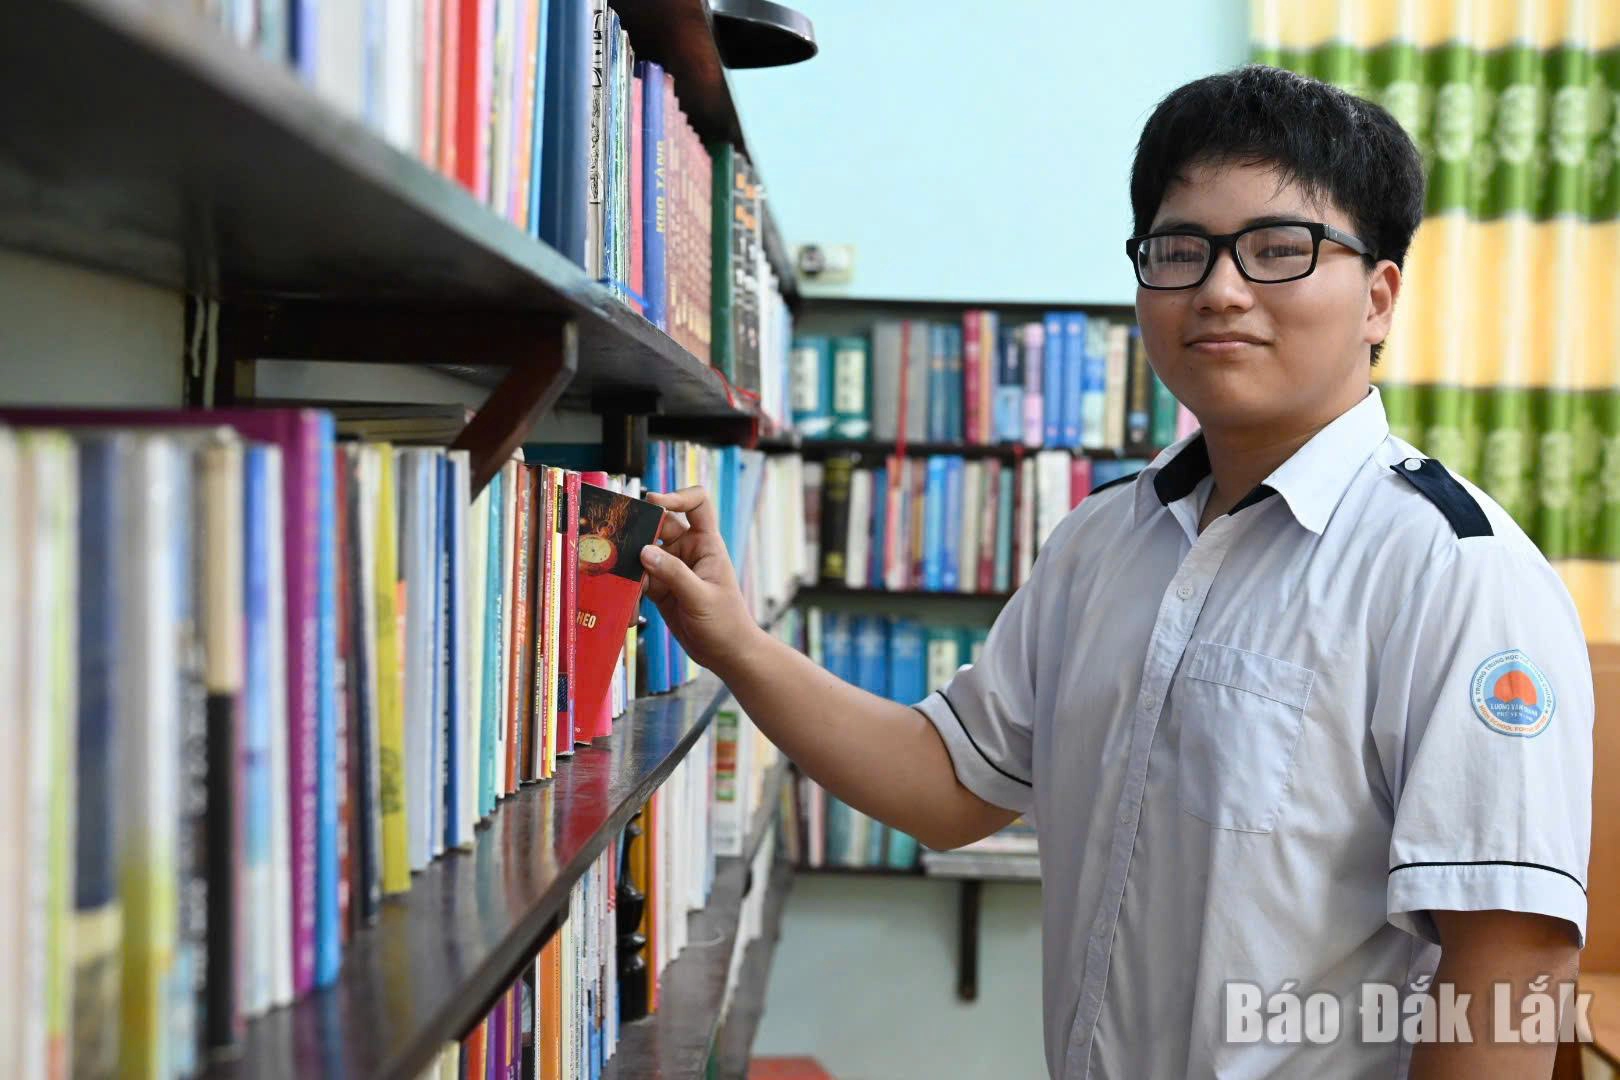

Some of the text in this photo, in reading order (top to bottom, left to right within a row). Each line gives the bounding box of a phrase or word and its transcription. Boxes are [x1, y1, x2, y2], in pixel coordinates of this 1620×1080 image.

[656, 196, 666, 233] KHO
[569, 538, 576, 548] 7
[1505, 654, 1519, 662] HỌC
